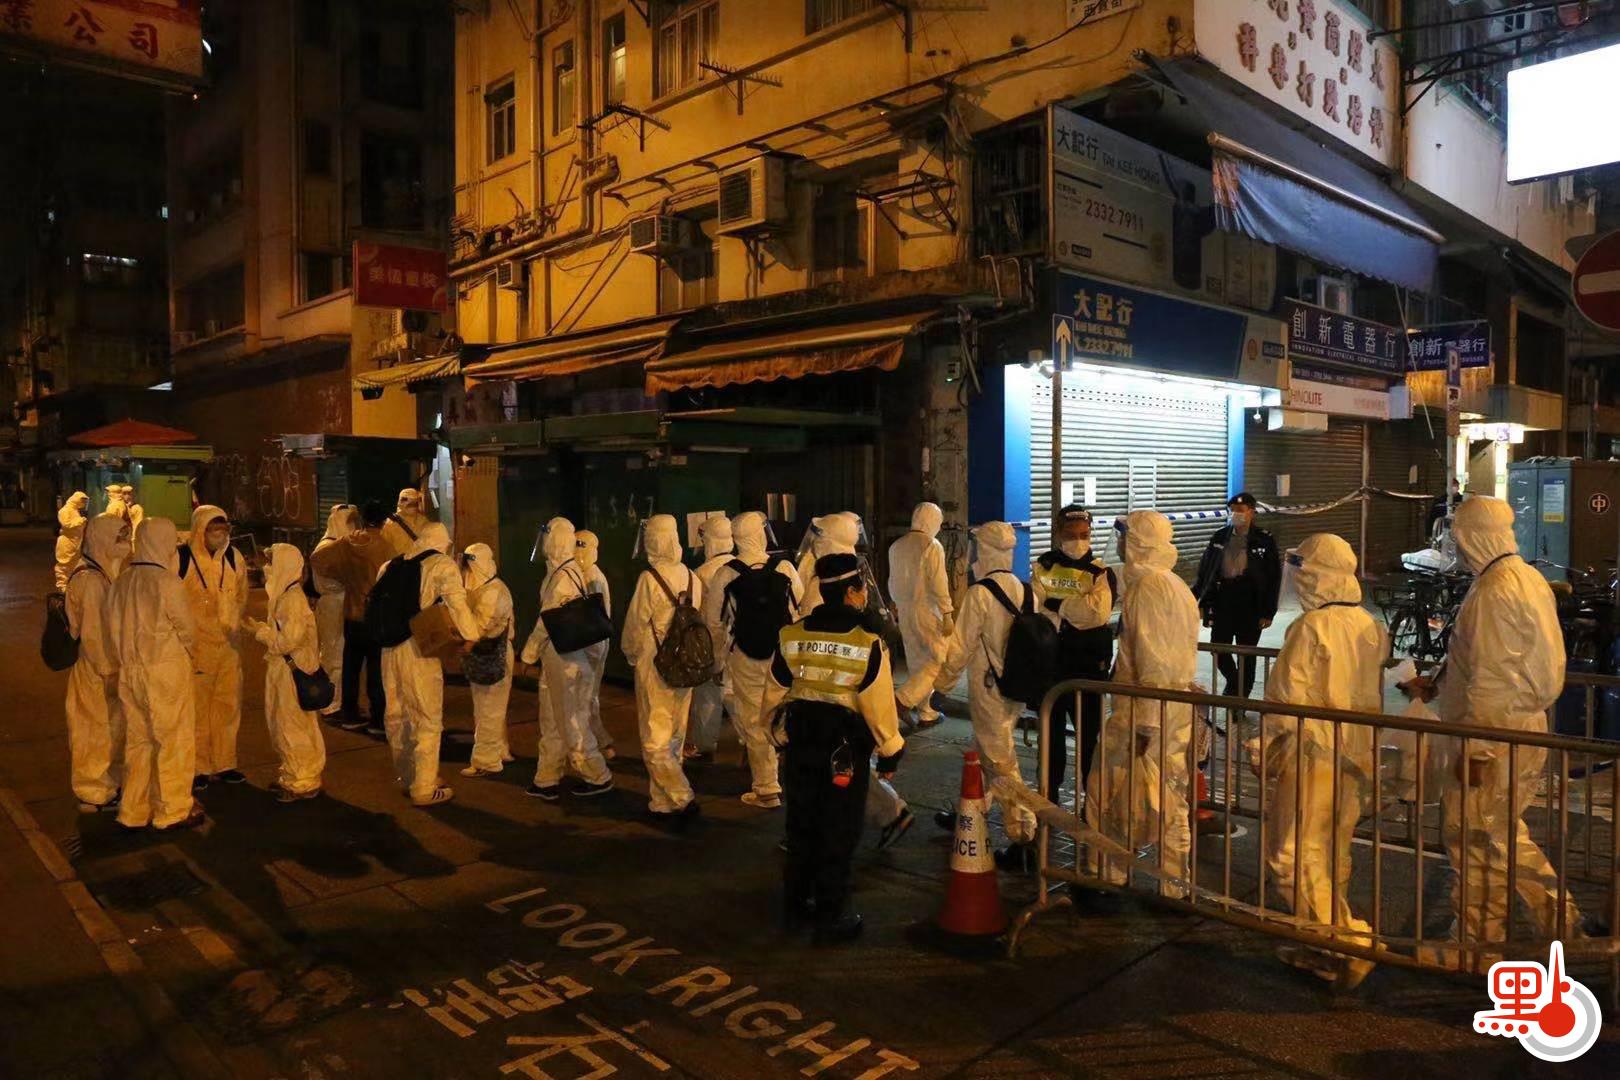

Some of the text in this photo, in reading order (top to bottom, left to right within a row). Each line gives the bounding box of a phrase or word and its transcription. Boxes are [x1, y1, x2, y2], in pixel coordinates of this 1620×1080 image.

[1057, 125, 1099, 161] 大記行
[1086, 199, 1115, 223] 2332
[1073, 288, 1134, 326] 大記行
[1292, 307, 1397, 359] 創新電器行
[806, 642, 838, 654] POLICE
[486, 888, 920, 1080] LOOK RIGHT
